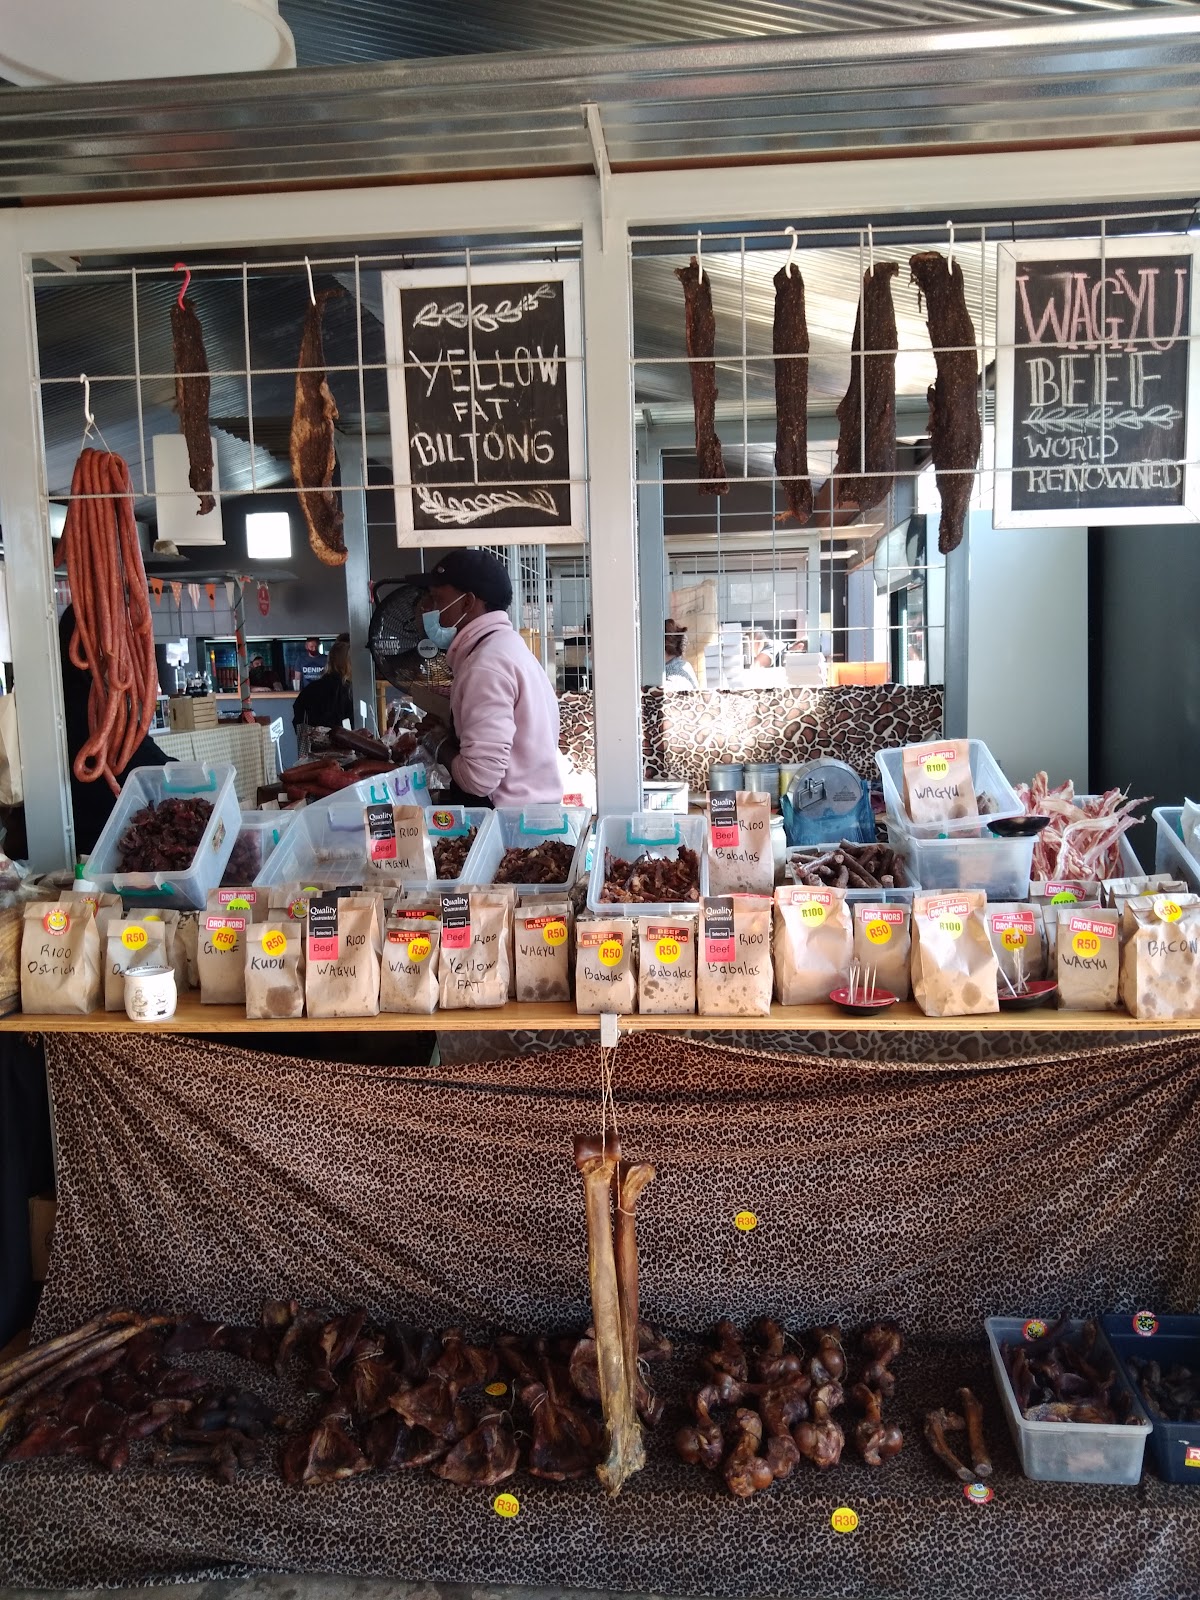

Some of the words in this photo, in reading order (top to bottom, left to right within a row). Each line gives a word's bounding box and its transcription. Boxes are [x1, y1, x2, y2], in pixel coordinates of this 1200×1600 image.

[1015, 268, 1187, 352] WAGYU
[408, 345, 559, 397] YELLOW
[1025, 351, 1162, 408] BEEF
[452, 398, 509, 422] FAT
[410, 431, 555, 466] BILTONG
[1024, 434, 1119, 461] WORLD
[1028, 457, 1182, 493] RENOWNED
[926, 763, 947, 772] R100
[914, 785, 960, 800] WAGYU
[711, 797, 736, 807] Quality
[369, 812, 393, 821] Quality
[738, 819, 764, 831] R100
[399, 827, 419, 839] R100
[715, 832, 734, 840] Beef
[375, 844, 392, 852] Beef
[715, 847, 760, 863] Babalas
[442, 897, 468, 906] Quality
[811, 892, 830, 903] WORS
[310, 905, 337, 916] Quality
[706, 906, 733, 916] Quality
[802, 907, 824, 918] R100
[1159, 904, 1177, 916] R50
[882, 911, 901, 922] WORS
[227, 920, 243, 929] WORS
[939, 922, 961, 931] R100
[1092, 925, 1113, 936] WORS
[446, 933, 466, 941] Beef
[547, 927, 565, 939] R50
[869, 924, 889, 938] R50
[126, 932, 145, 943] R50
[216, 932, 234, 944] R50
[265, 935, 285, 951] R50
[346, 934, 366, 946] R100
[740, 933, 764, 946] R100
[1077, 938, 1097, 949] R50
[40, 943, 72, 959] R100
[313, 944, 334, 952] Beef
[411, 944, 429, 955] R50
[519, 944, 555, 958] WAGYU
[602, 948, 621, 958] R50
[659, 945, 678, 956] R50
[709, 944, 730, 953] Beef
[1148, 937, 1199, 957] BACON
[28, 960, 75, 976] Ostrich
[388, 961, 421, 975] WAGYU
[449, 957, 497, 975] Yellow
[1062, 954, 1108, 971] WAGYU
[317, 964, 357, 979] WAGYU
[584, 967, 623, 982] Babalas
[708, 962, 761, 976] Babalas
[457, 979, 484, 994] FAT
[737, 1217, 756, 1226] R30
[497, 1499, 518, 1514] R30
[834, 1515, 857, 1527] R30
